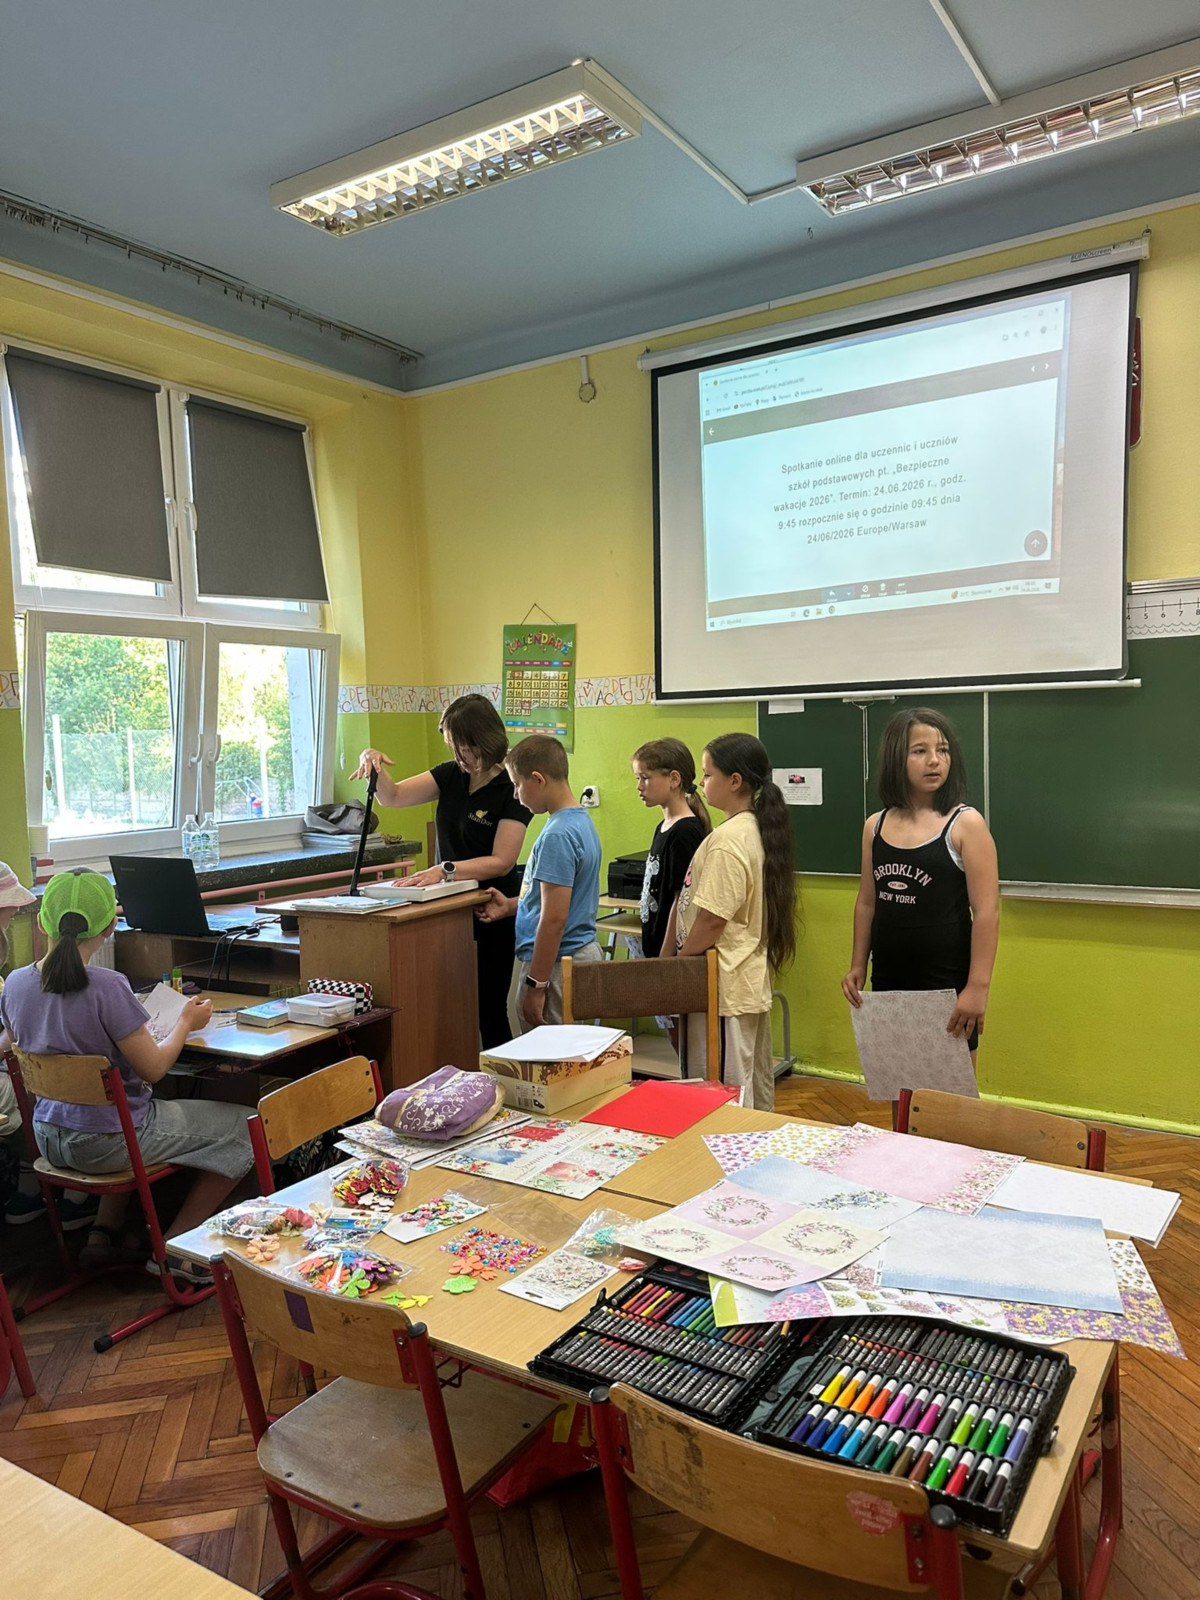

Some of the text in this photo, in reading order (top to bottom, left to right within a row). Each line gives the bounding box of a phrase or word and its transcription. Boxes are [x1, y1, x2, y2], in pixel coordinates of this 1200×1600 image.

[781, 435, 958, 476] Spotkanie online dla uczennic i uczniów
[788, 480, 810, 492] szkół
[813, 466, 875, 489] podstawowych
[877, 466, 889, 478] pt.
[774, 499, 807, 513] wakacje
[839, 489, 871, 501] Termin:
[874, 480, 924, 496] 24.06.2026
[927, 479, 937, 488] r.,
[940, 473, 966, 487] godz.
[778, 519, 796, 530] 9:45
[799, 510, 844, 528] rozpocznie
[846, 508, 860, 520] się
[871, 502, 908, 518] godzinie
[911, 498, 938, 509] 09:45
[940, 494, 960, 505] dnia
[807, 518, 927, 544] 24/06/2026 Europe/Warsaw
[507, 632, 569, 655] KALENDARZ
[874, 863, 932, 886] BROOKLYN
[879, 890, 916, 904] NEW YORK
